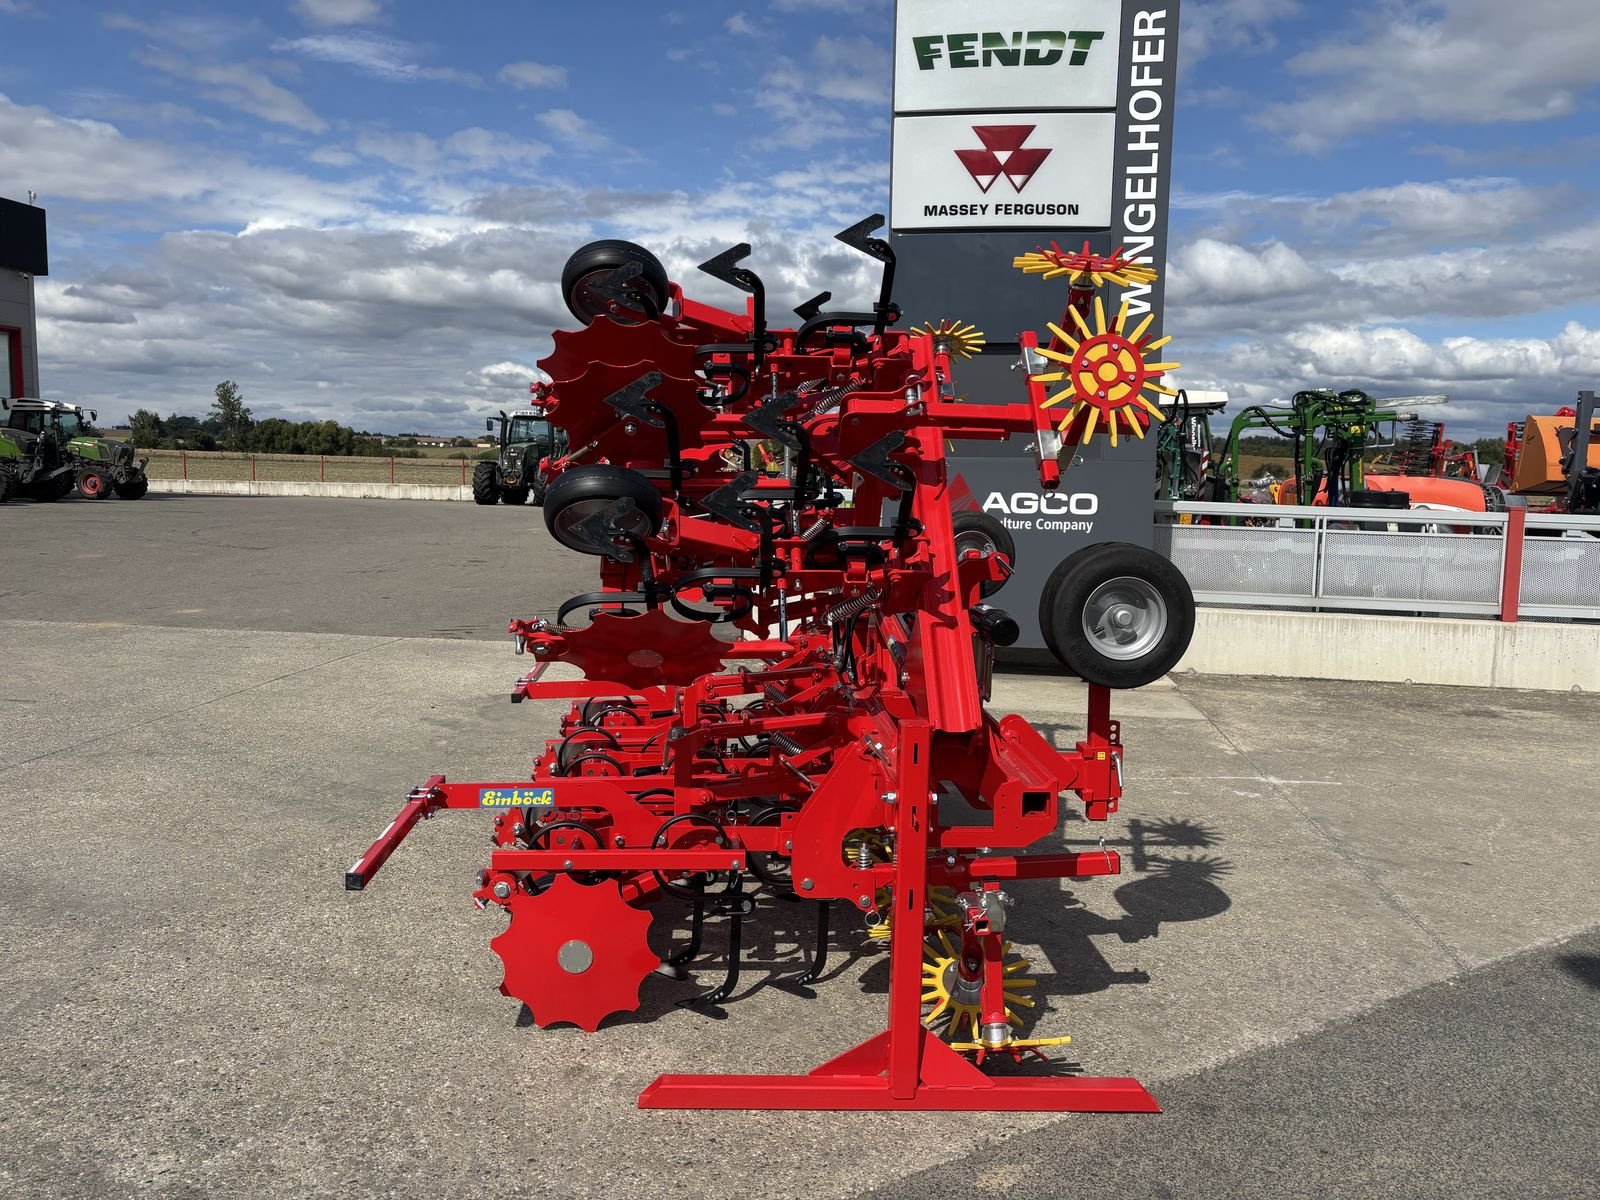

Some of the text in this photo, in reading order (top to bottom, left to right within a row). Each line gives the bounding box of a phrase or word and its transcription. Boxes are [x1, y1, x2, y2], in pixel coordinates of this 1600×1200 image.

[912, 31, 1105, 70] FENDT
[1121, 9, 1166, 317] WNGELHOFER
[924, 204, 1079, 216] MASSEY FERGUSON
[982, 491, 1098, 515] AGCO
[1000, 517, 1094, 534] lture Company
[482, 790, 552, 806] Einböck
